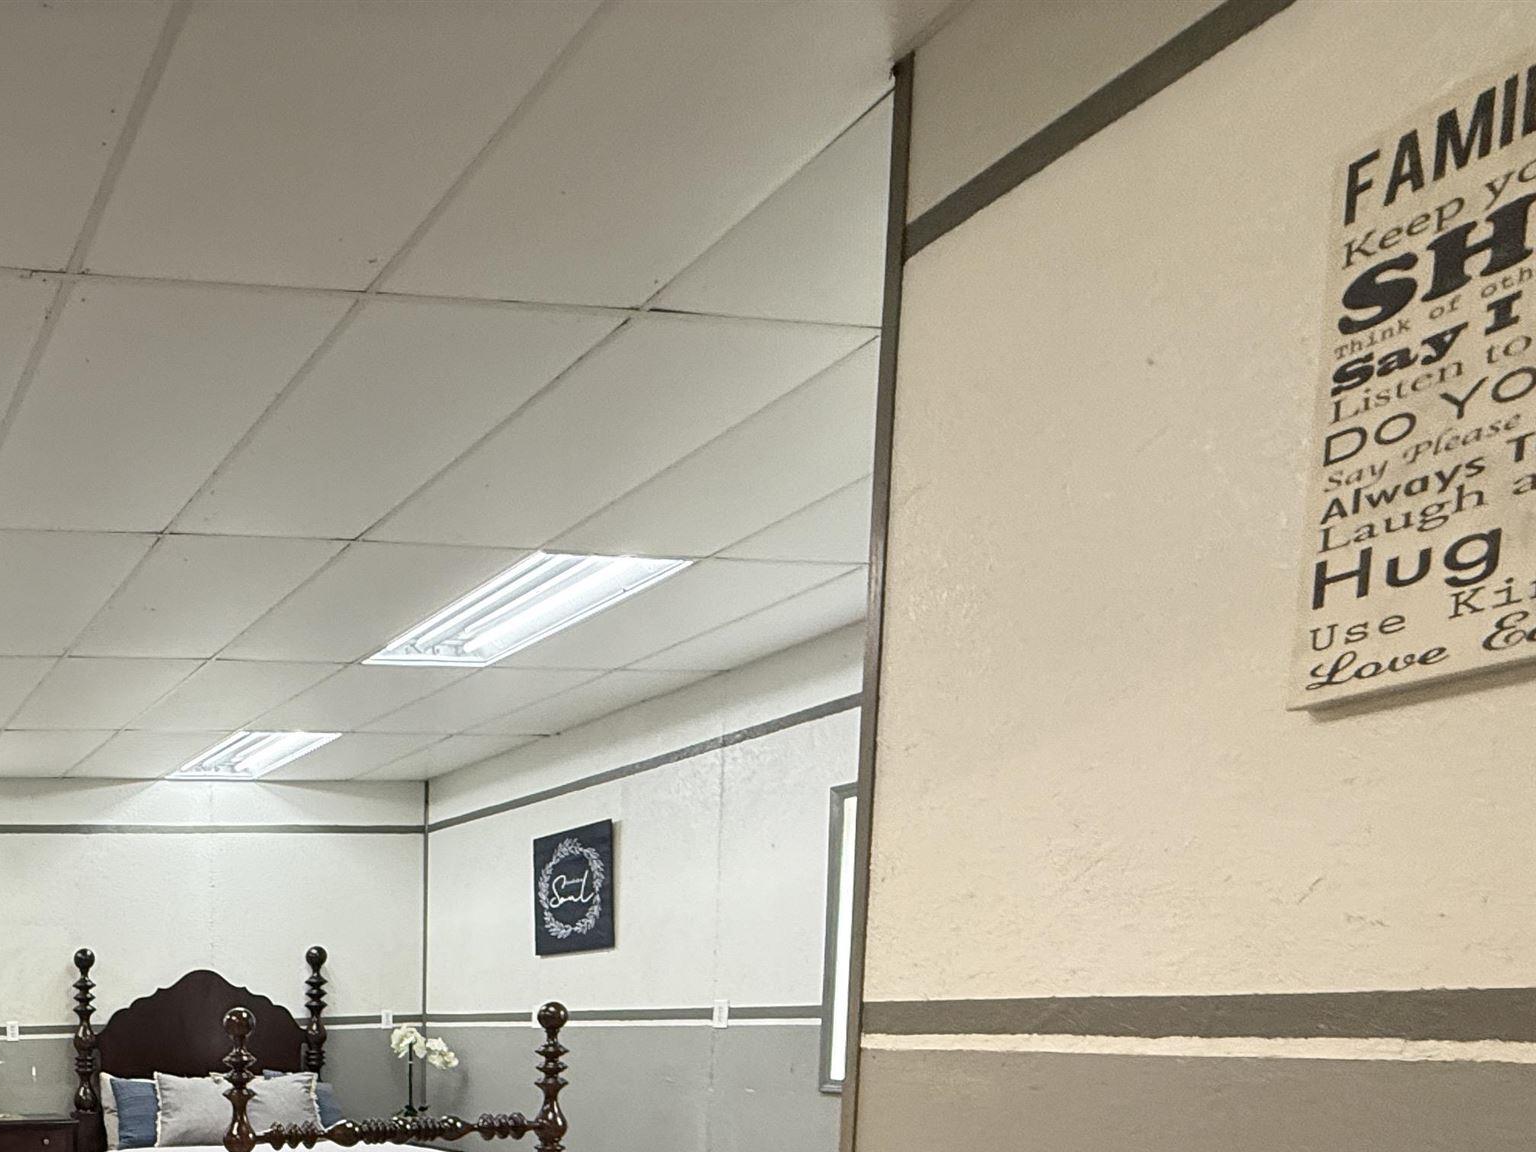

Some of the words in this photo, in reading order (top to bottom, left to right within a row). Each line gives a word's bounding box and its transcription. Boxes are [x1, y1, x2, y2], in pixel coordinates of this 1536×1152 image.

[1337, 192, 1536, 335] SH
[1341, 197, 1465, 270] Keep
[1333, 319, 1412, 360] Think
[1428, 294, 1462, 320] of
[1480, 267, 1534, 299] oth
[1484, 289, 1524, 337] I
[1322, 411, 1417, 467] DO
[1439, 366, 1536, 420] YO
[1328, 360, 1464, 426] Listen
[1486, 334, 1533, 364] to
[1320, 456, 1486, 525] Always
[1323, 461, 1389, 494] Say
[1402, 414, 1523, 465] Please
[1317, 483, 1489, 554] Laugh
[1312, 527, 1503, 611] Hug
[1309, 614, 1406, 651] Use
[1447, 577, 1536, 619] Ki
[1305, 646, 1451, 691] Love
